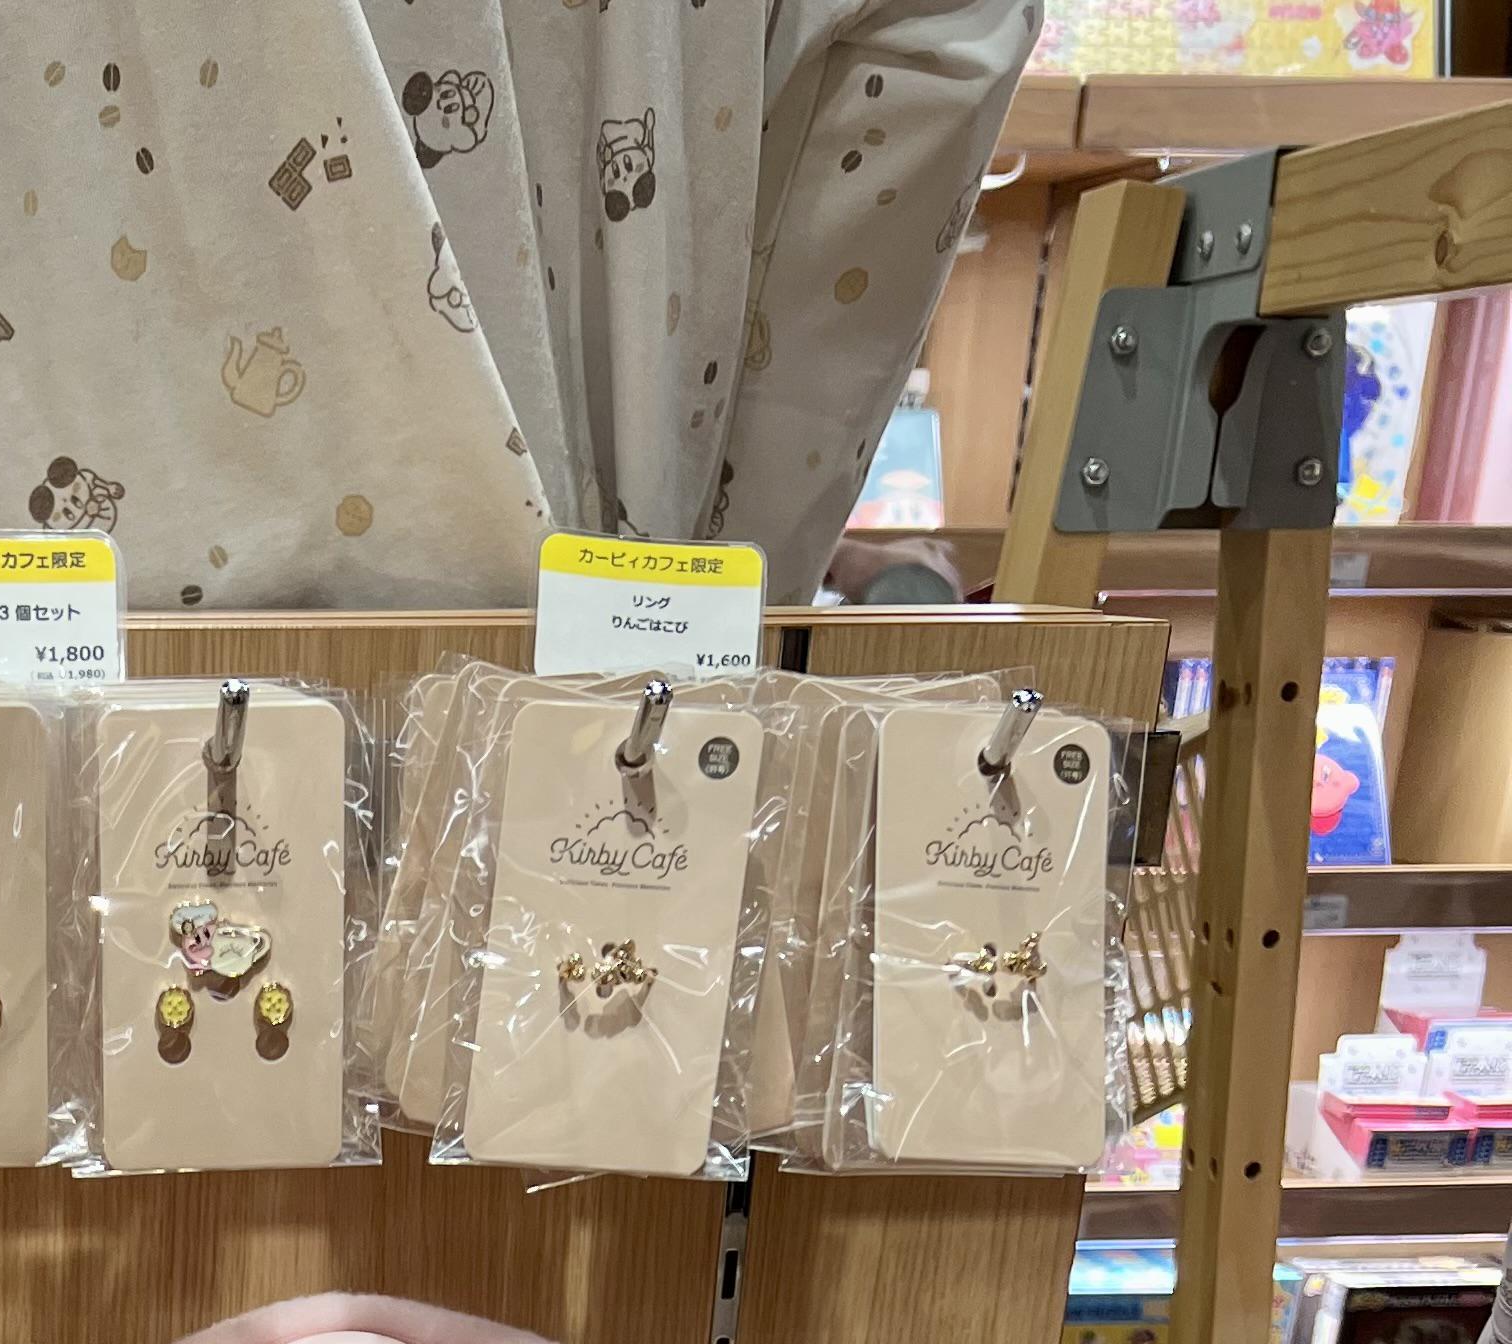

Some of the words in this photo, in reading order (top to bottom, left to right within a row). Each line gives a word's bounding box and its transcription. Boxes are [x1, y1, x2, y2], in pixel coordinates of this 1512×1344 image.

[578, 548, 724, 574] カービィカフェ限定
[633, 595, 671, 609] リング
[611, 616, 688, 634] りんごはこび
[34, 645, 104, 665] ¥1,800
[696, 654, 751, 669] ¥1,600
[155, 840, 236, 876] Kirby
[235, 838, 292, 876] Café
[550, 837, 630, 876] Kirby
[631, 842, 688, 880] Café
[925, 840, 1001, 877] Kirby
[1000, 845, 1054, 881] Café
